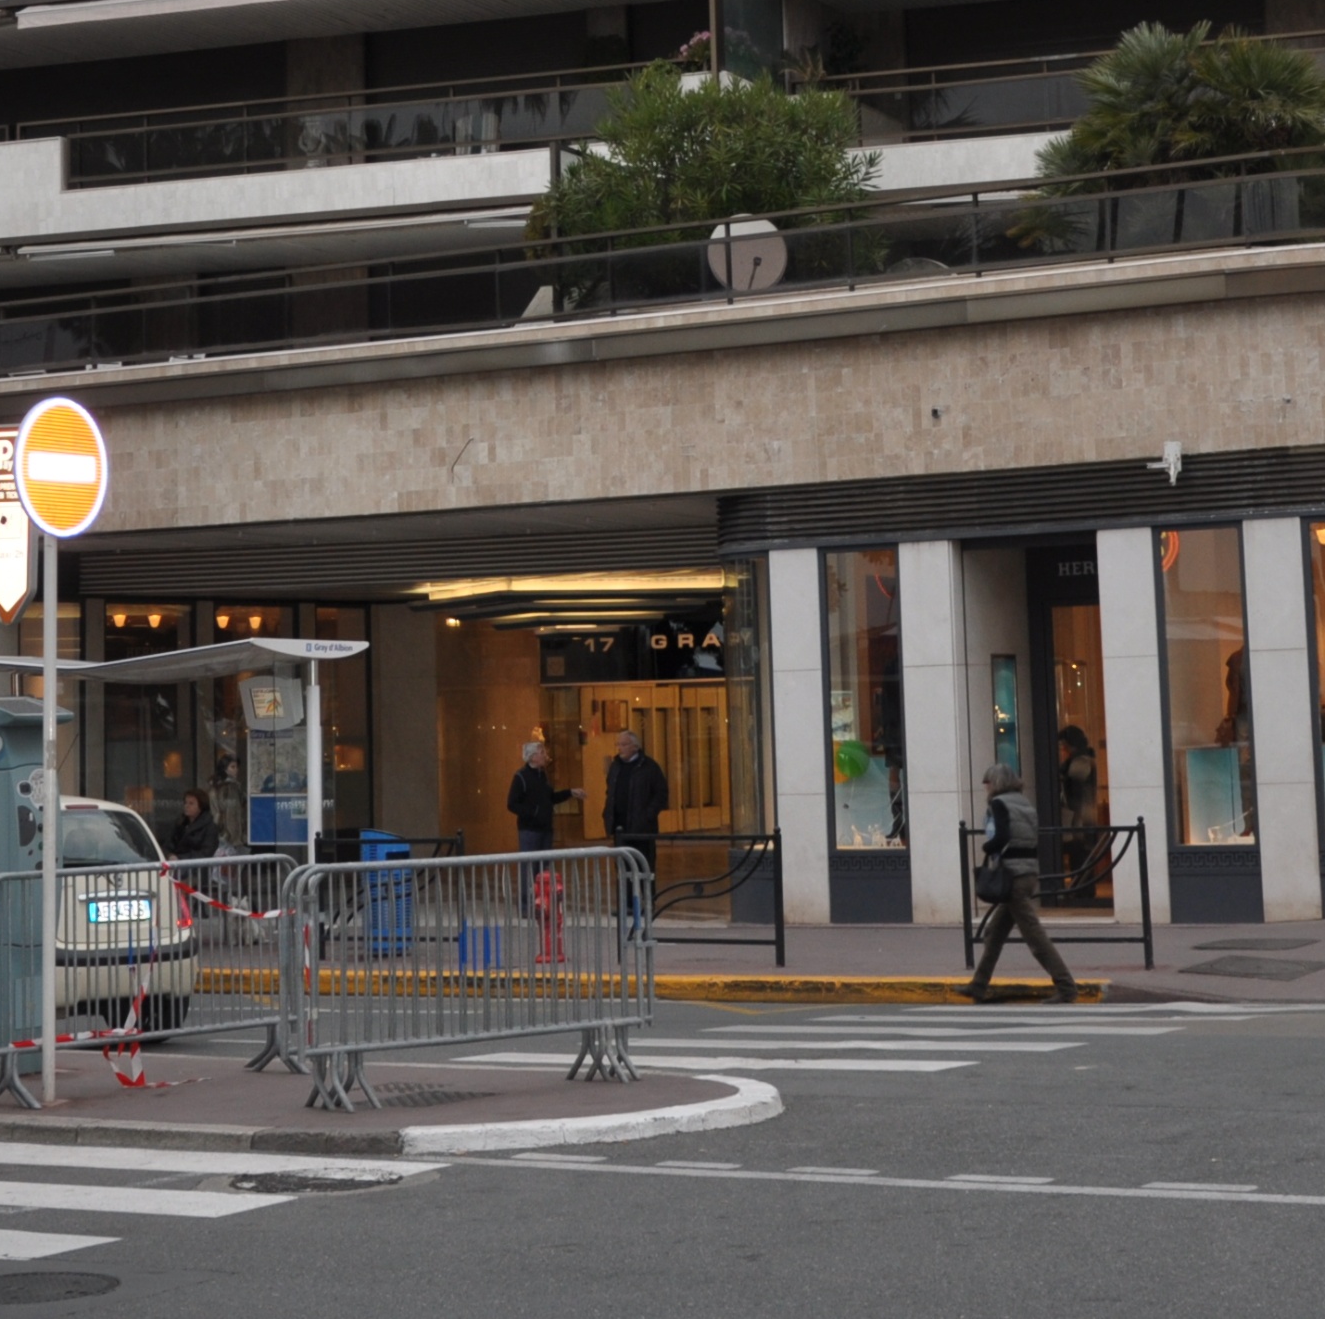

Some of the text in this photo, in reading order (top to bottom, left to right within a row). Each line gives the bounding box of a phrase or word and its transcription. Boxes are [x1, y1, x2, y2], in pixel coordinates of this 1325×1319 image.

[1058, 561, 1095, 576] HER
[314, 643, 353, 653] Gray d'Albion
[584, 637, 614, 652] 17
